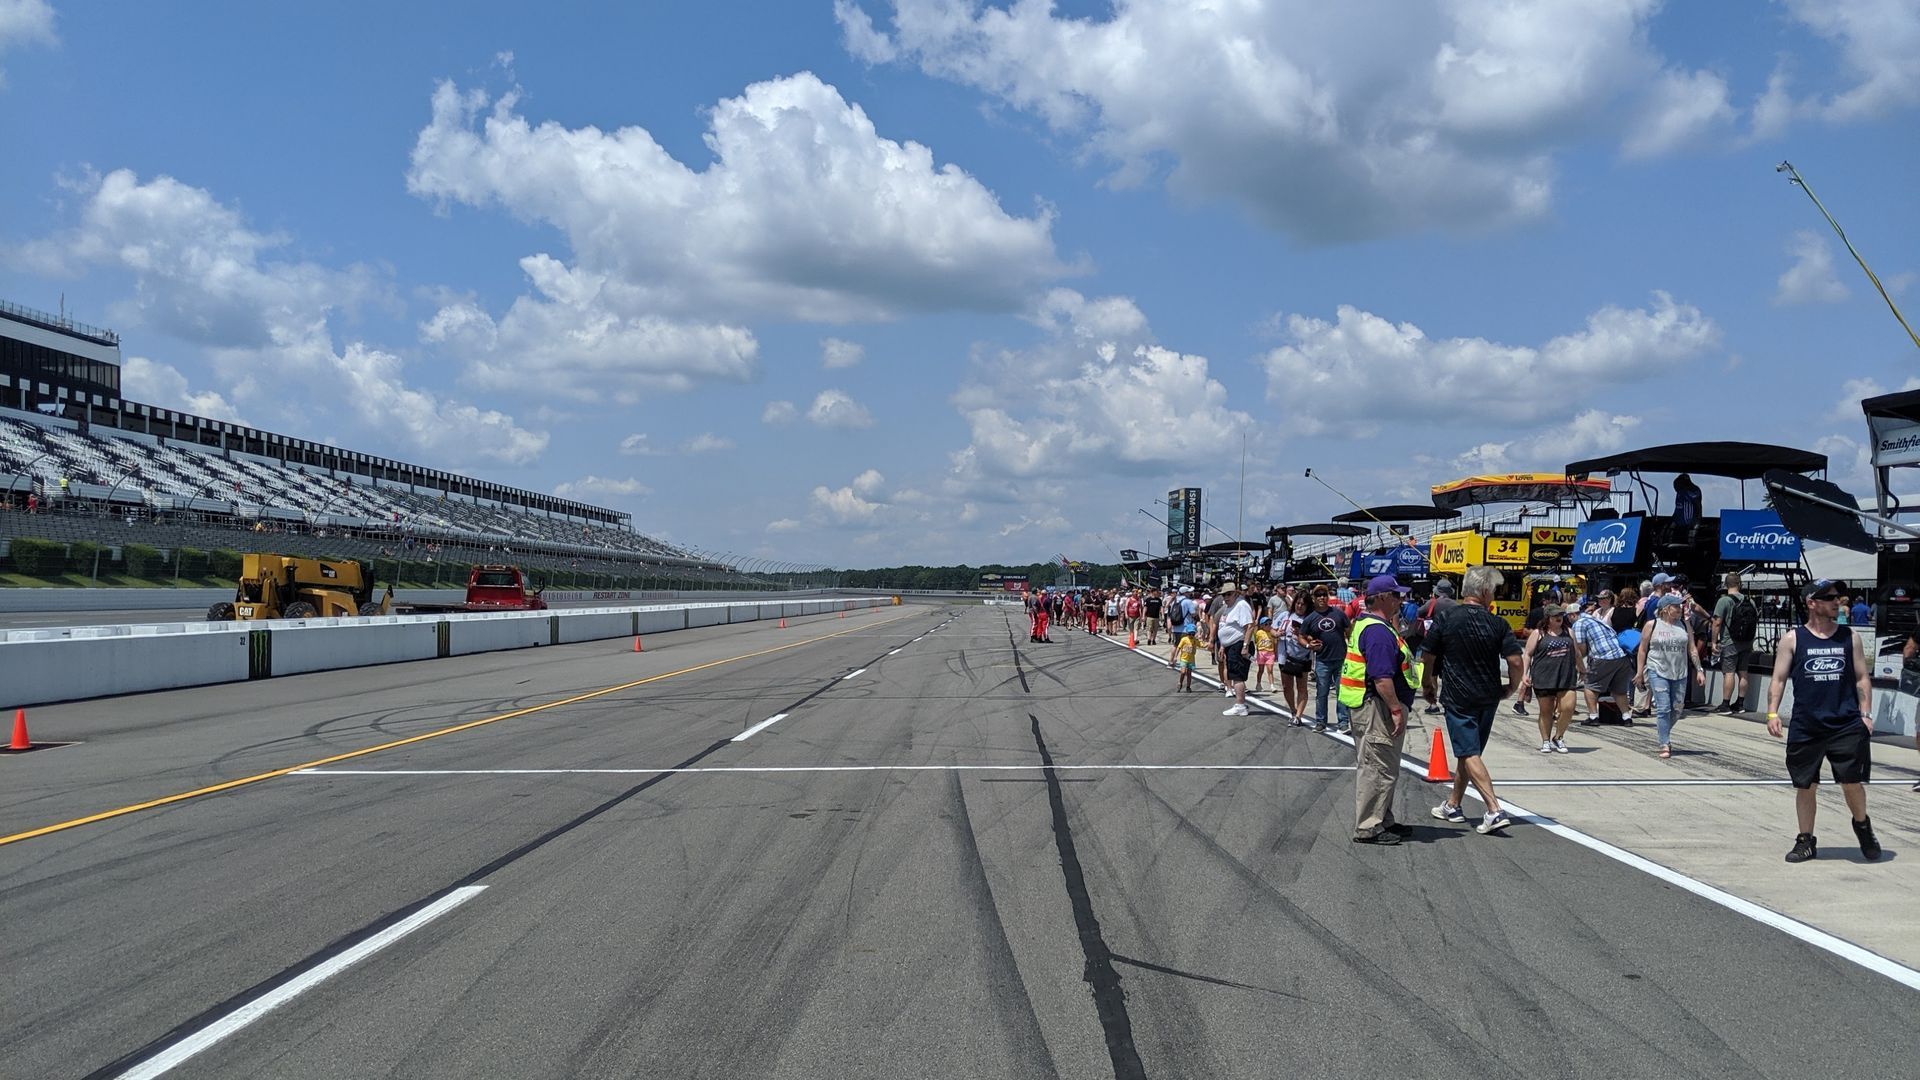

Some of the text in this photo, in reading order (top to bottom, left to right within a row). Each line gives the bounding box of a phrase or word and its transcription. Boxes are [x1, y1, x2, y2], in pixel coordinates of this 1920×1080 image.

[1188, 516, 1196, 545] VISION
[1725, 532, 1795, 545] CreditOne
[1497, 539, 1518, 552] 34
[1582, 535, 1626, 555] CreditOne
[1402, 551, 1419, 563] Kroger
[1443, 541, 1464, 564] Love's
[1369, 559, 1392, 574] 37
[1537, 584, 1550, 593] 24
[592, 591, 617, 600] RESTART
[239, 607, 253, 616] CAT
[1497, 605, 1528, 616] Love's
[1807, 647, 1845, 656] AMERICAN PRIDE
[1812, 659, 1839, 670] Ford
